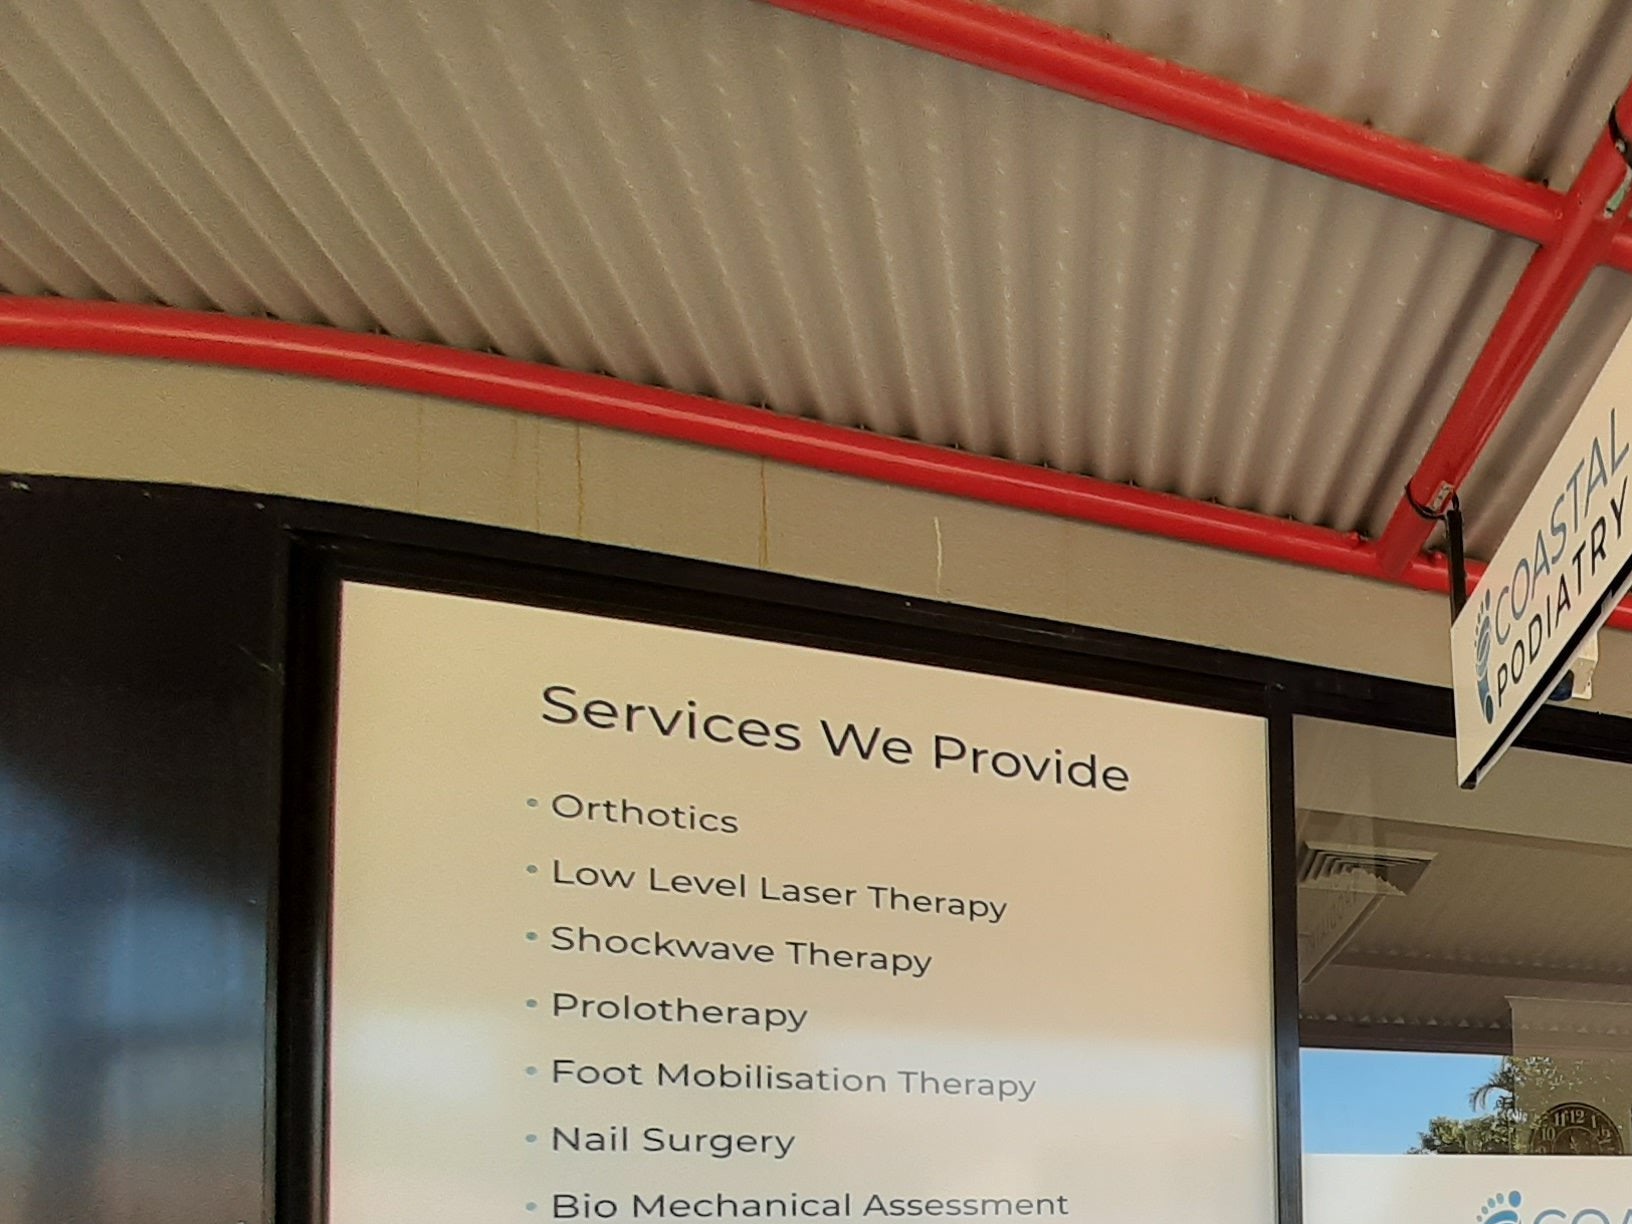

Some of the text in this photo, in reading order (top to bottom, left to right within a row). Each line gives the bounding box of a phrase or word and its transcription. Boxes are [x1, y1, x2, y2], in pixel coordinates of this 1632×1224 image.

[1495, 408, 1630, 647] COASTAL
[1496, 476, 1629, 708] PODIATRY
[543, 686, 1128, 791] Services We Provide
[552, 794, 738, 833] Orthotics
[554, 860, 1007, 923] Low Level Laser Therapy
[552, 927, 931, 977] Shockwave Therapy
[554, 993, 807, 1032] Prolotherapy
[554, 1060, 1036, 1102] Foot Mobilisation Therapy
[554, 1126, 795, 1159] Nail Surgery
[554, 1193, 1068, 1218] Bio Mechanical Assessment
